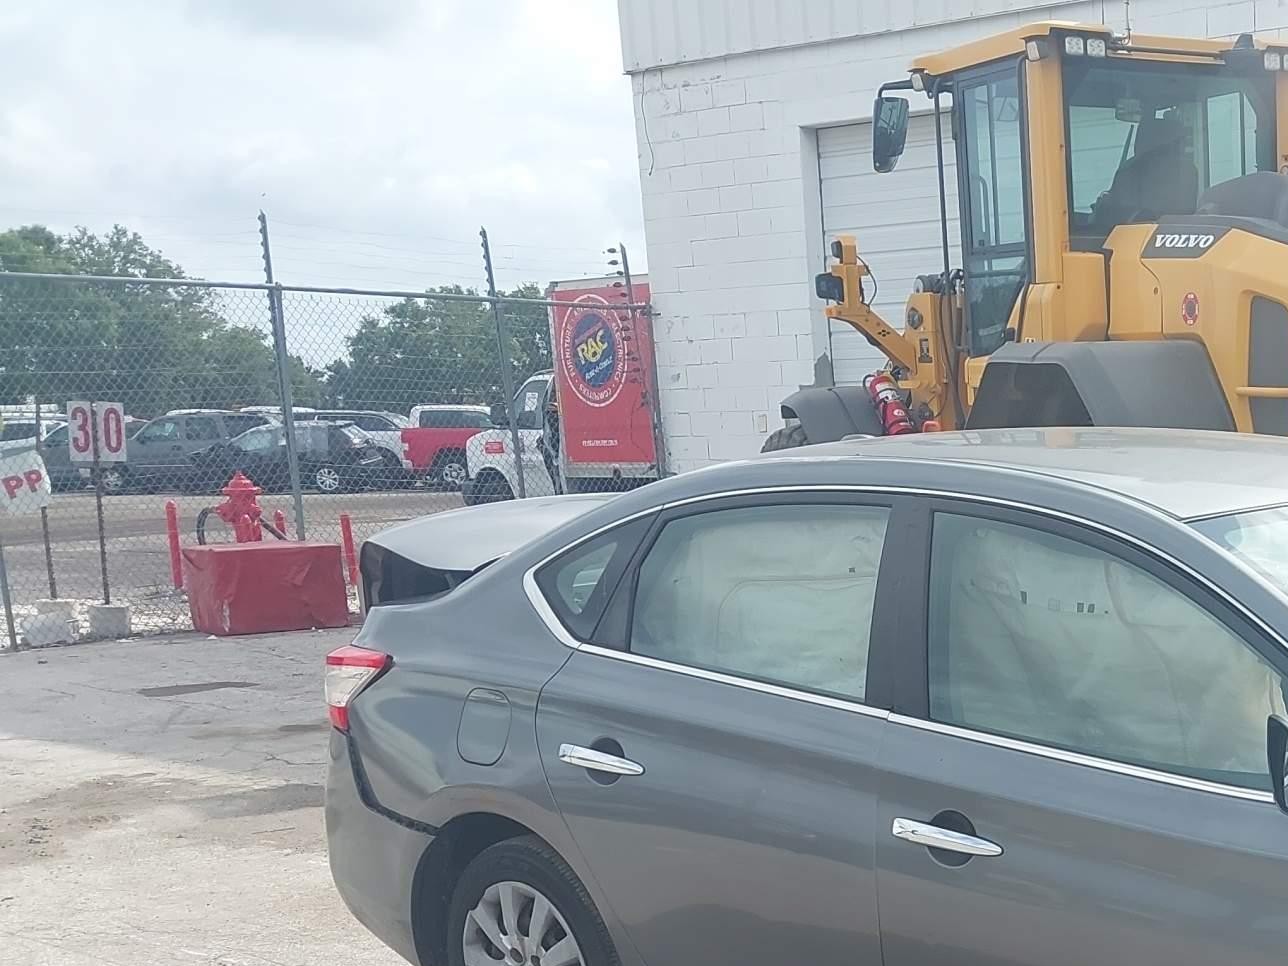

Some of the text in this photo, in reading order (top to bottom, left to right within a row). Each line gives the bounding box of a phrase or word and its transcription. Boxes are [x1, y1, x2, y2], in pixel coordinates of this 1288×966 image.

[1154, 234, 1215, 248] VOLVO
[577, 329, 608, 365] RAC
[71, 406, 122, 453] 30
